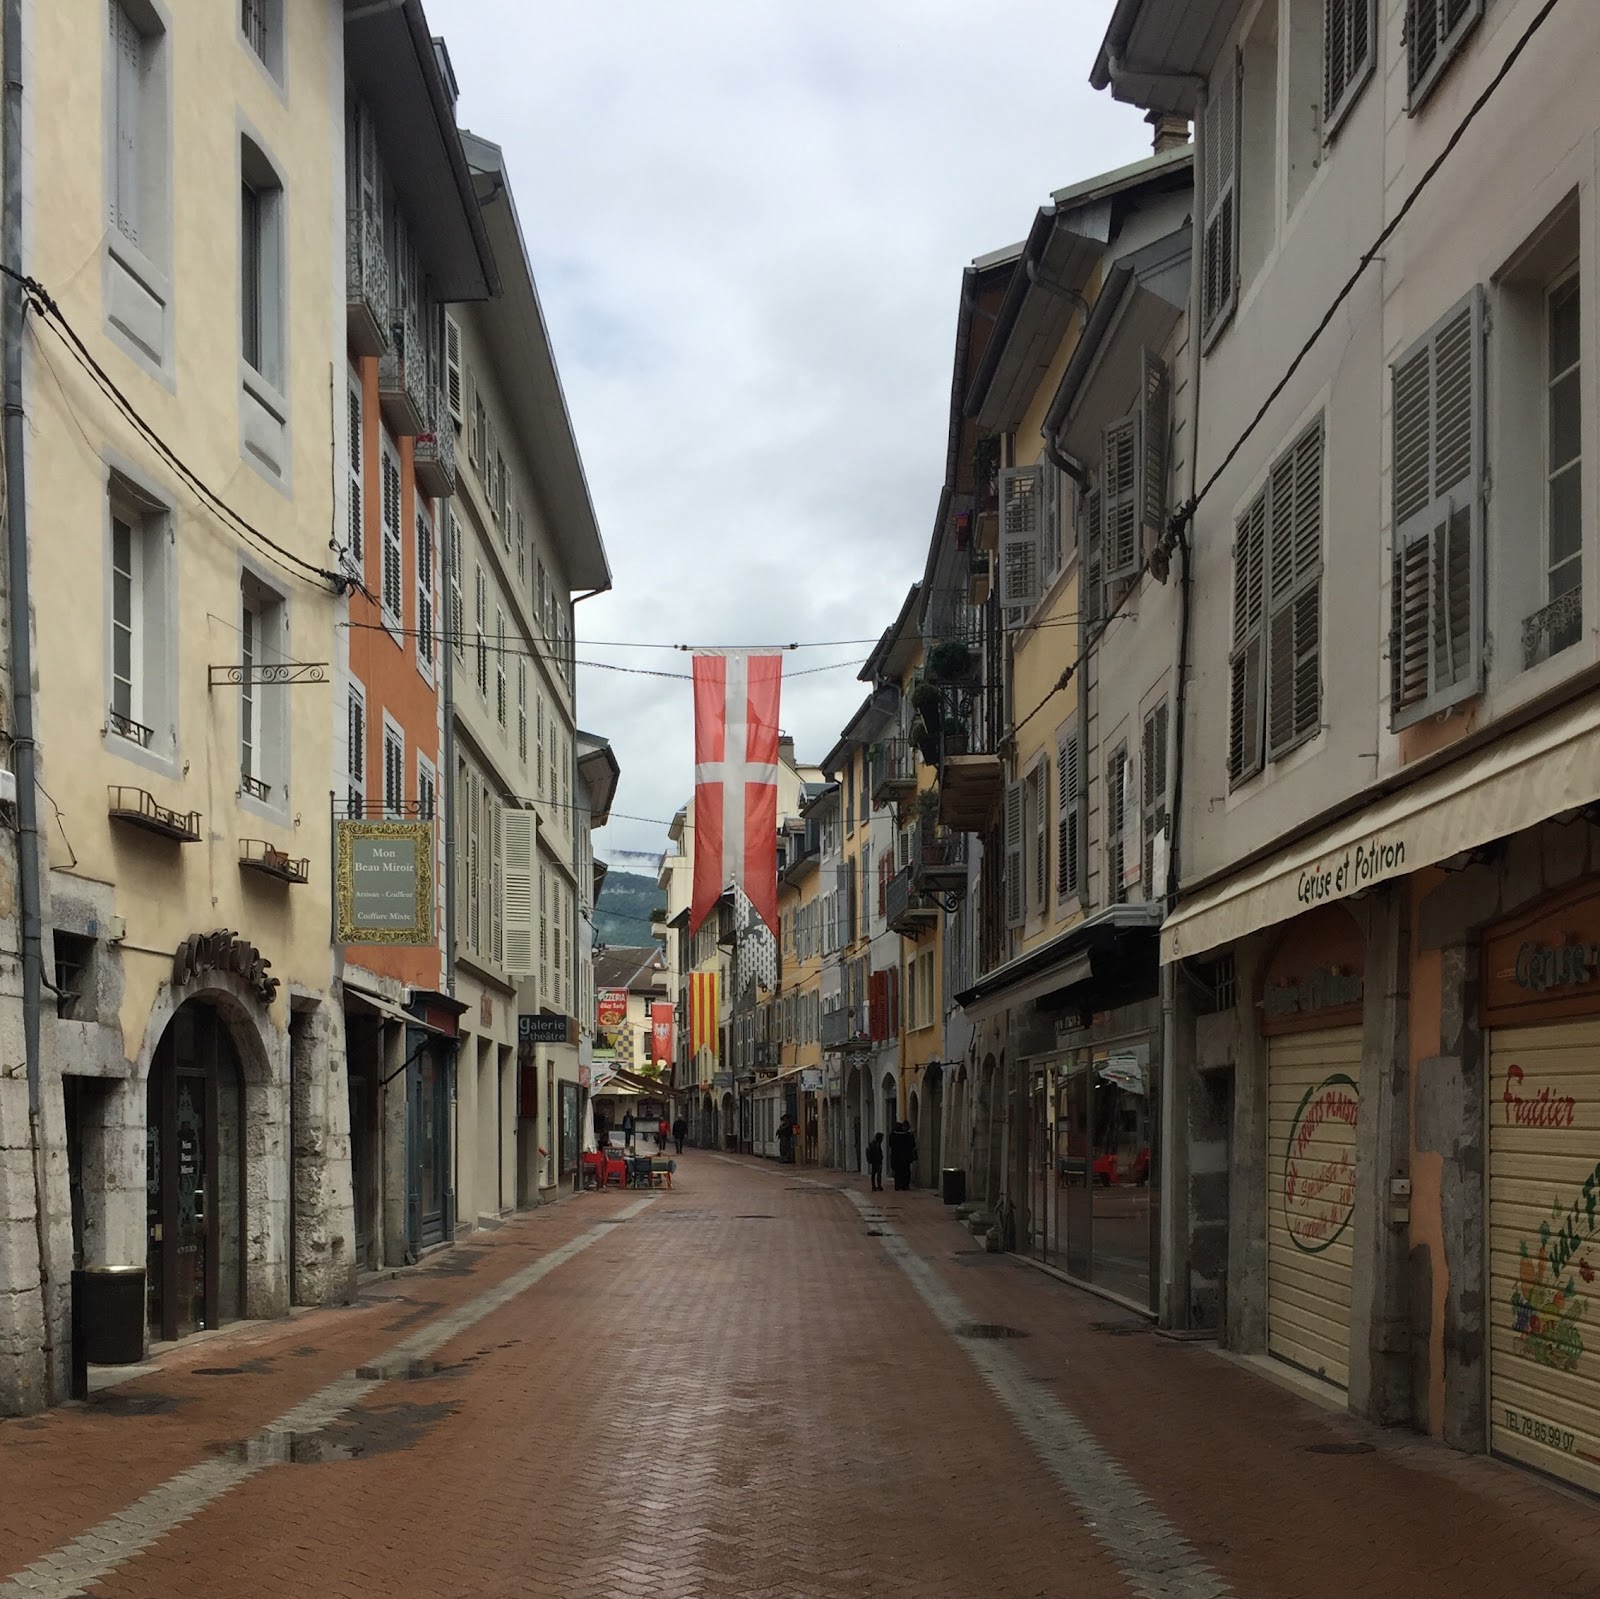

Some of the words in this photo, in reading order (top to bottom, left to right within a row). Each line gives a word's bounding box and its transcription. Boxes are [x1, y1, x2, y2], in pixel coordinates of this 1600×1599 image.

[372, 848, 396, 858] Mon
[355, 862, 380, 872] Beau
[382, 862, 414, 872] Miroir
[1298, 866, 1332, 904] Cerise
[1336, 852, 1350, 892] et
[1355, 839, 1405, 887] Potiron
[357, 911, 387, 921] Coiffure
[389, 912, 411, 921] Mixte
[519, 1017, 565, 1035] galerie
[530, 1032, 565, 1041] théâtre
[1504, 1409, 1520, 1431] TEL
[1522, 1416, 1533, 1436] 79
[1534, 1421, 1546, 1441] 85
[1548, 1426, 1561, 1446] 99
[1563, 1432, 1575, 1452] 07
